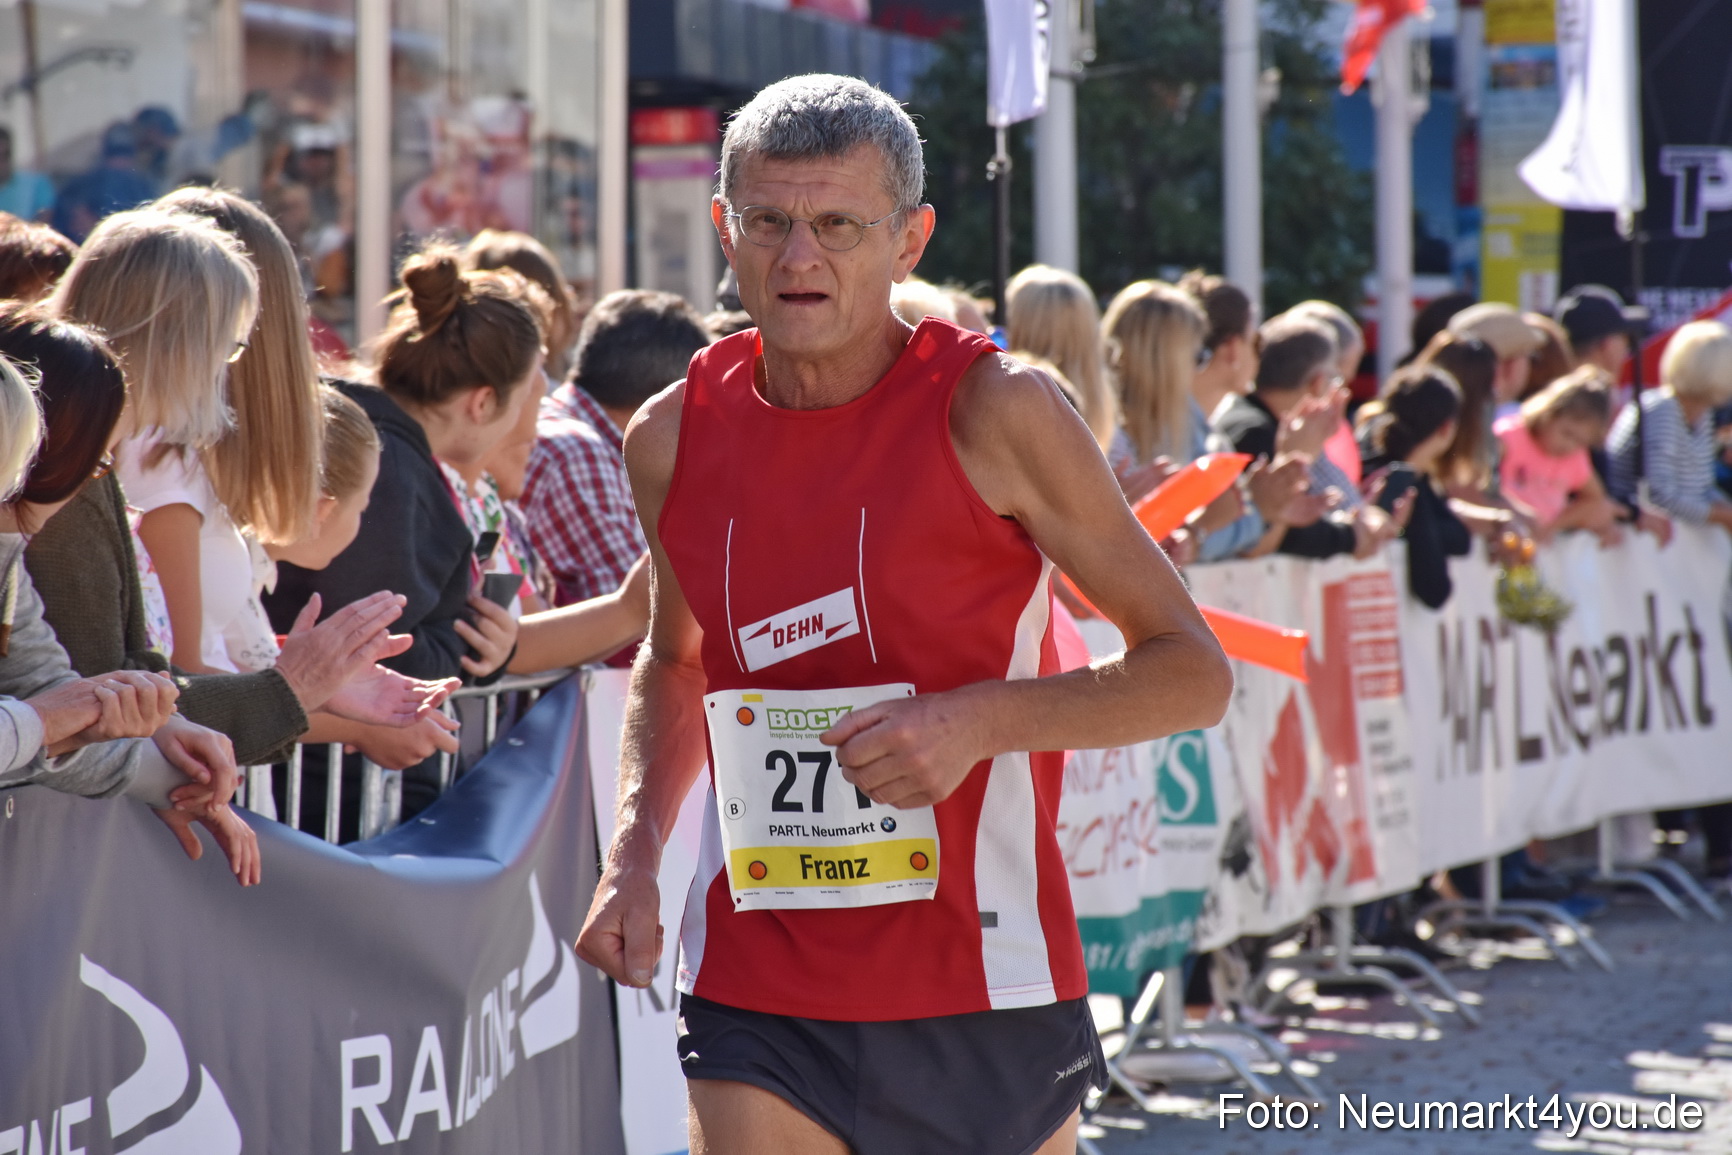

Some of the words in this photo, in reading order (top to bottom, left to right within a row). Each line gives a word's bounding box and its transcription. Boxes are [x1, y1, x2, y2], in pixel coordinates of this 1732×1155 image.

[773, 612, 825, 650] DEHN
[766, 704, 854, 731] BOCK
[769, 731, 795, 741] inspired
[795, 731, 804, 741] by
[730, 804, 740, 815] B
[769, 825, 810, 837] PARTL
[811, 822, 876, 838] Neumarkt
[800, 853, 871, 880] Franz
[341, 967, 519, 1153] RAILONE
